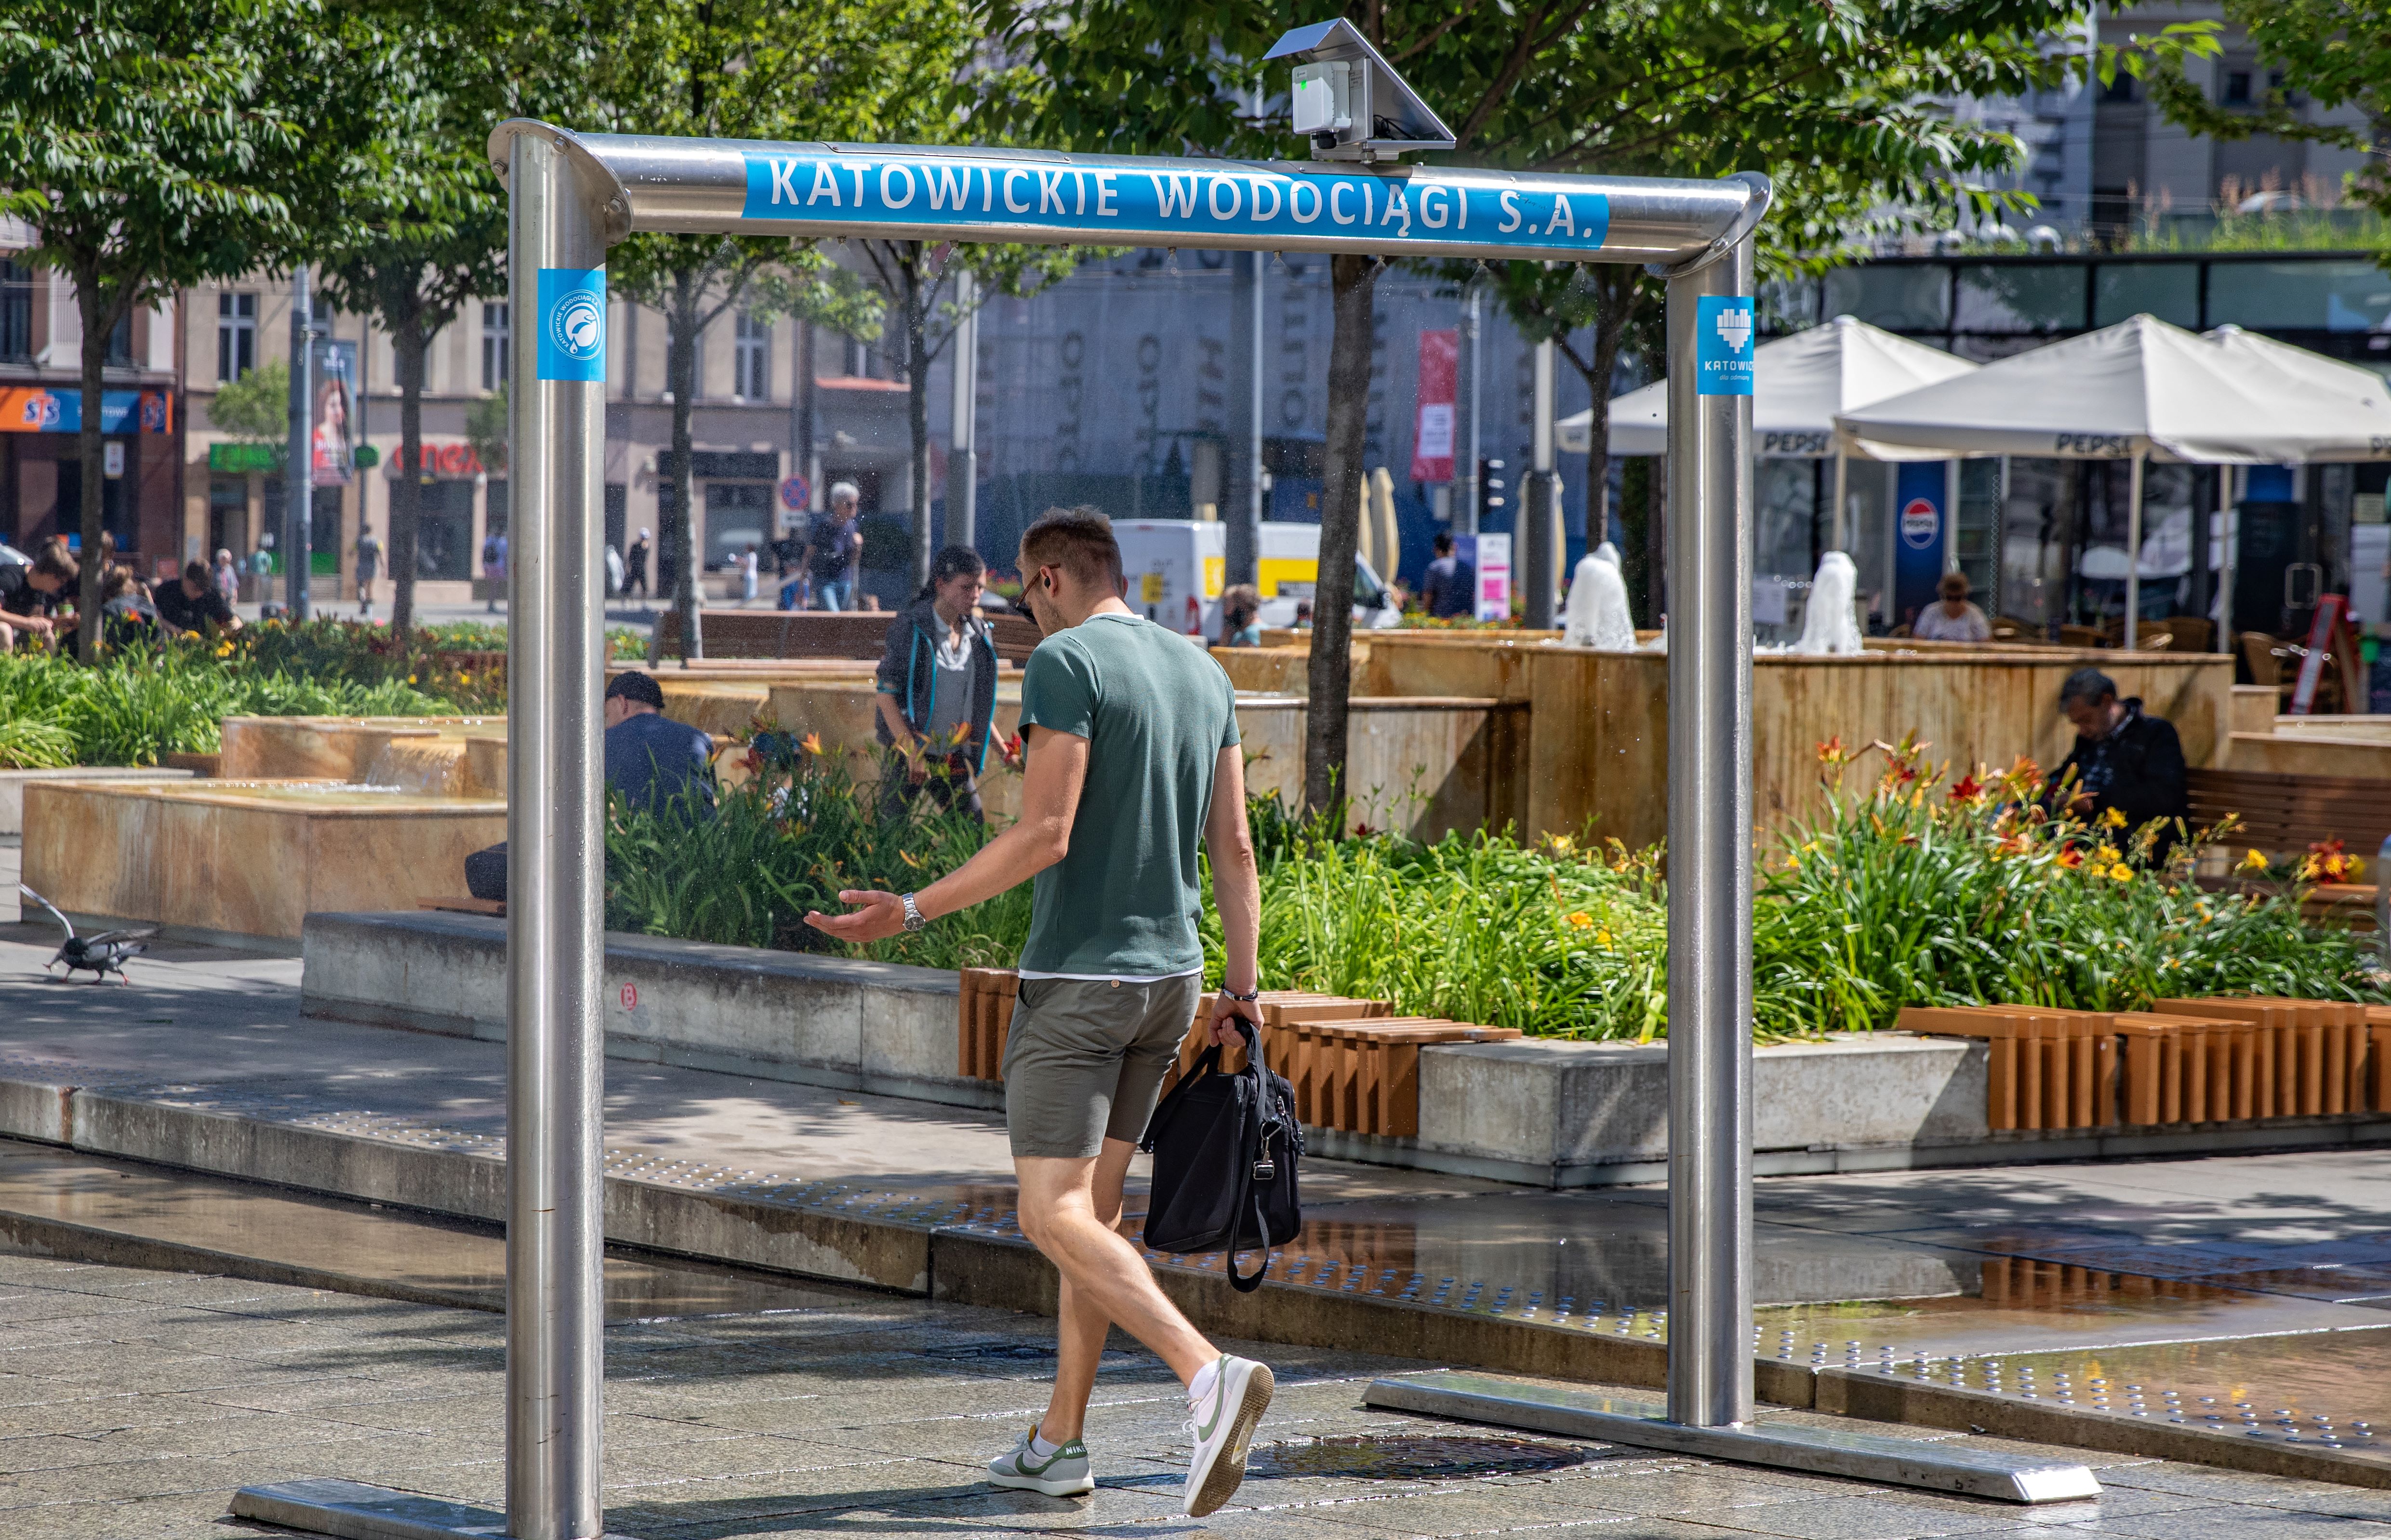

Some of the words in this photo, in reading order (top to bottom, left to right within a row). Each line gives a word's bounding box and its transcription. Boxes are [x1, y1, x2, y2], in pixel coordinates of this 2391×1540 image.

[770, 159, 1119, 216] KATOWICKIE
[1150, 173, 1467, 238] WODOCIĄGI
[1497, 189, 1594, 239] S.A.
[560, 295, 591, 311] WODOCIĄGI
[555, 311, 569, 347] KATOWICKIE
[22, 393, 61, 425] STS
[1764, 431, 1829, 452] PEPSI
[1065, 1446, 1086, 1455] NIKE
